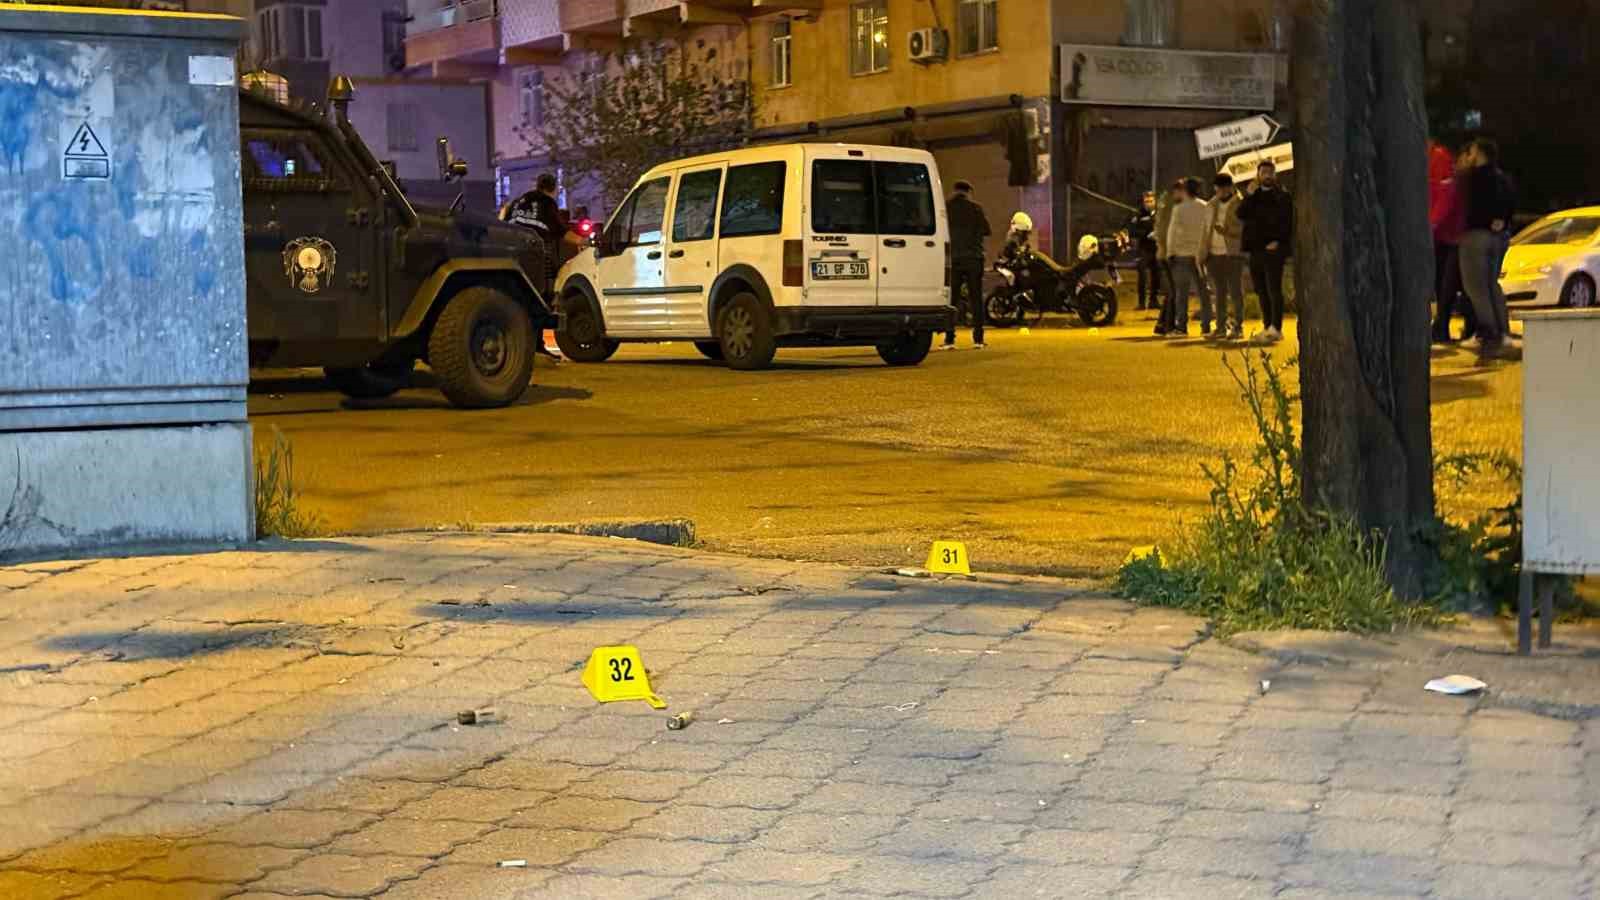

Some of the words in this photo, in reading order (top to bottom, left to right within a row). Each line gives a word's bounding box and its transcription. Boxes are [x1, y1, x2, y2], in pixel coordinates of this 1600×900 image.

[817, 263, 828, 275] 21
[943, 548, 958, 565] 31
[609, 657, 635, 682] 32
